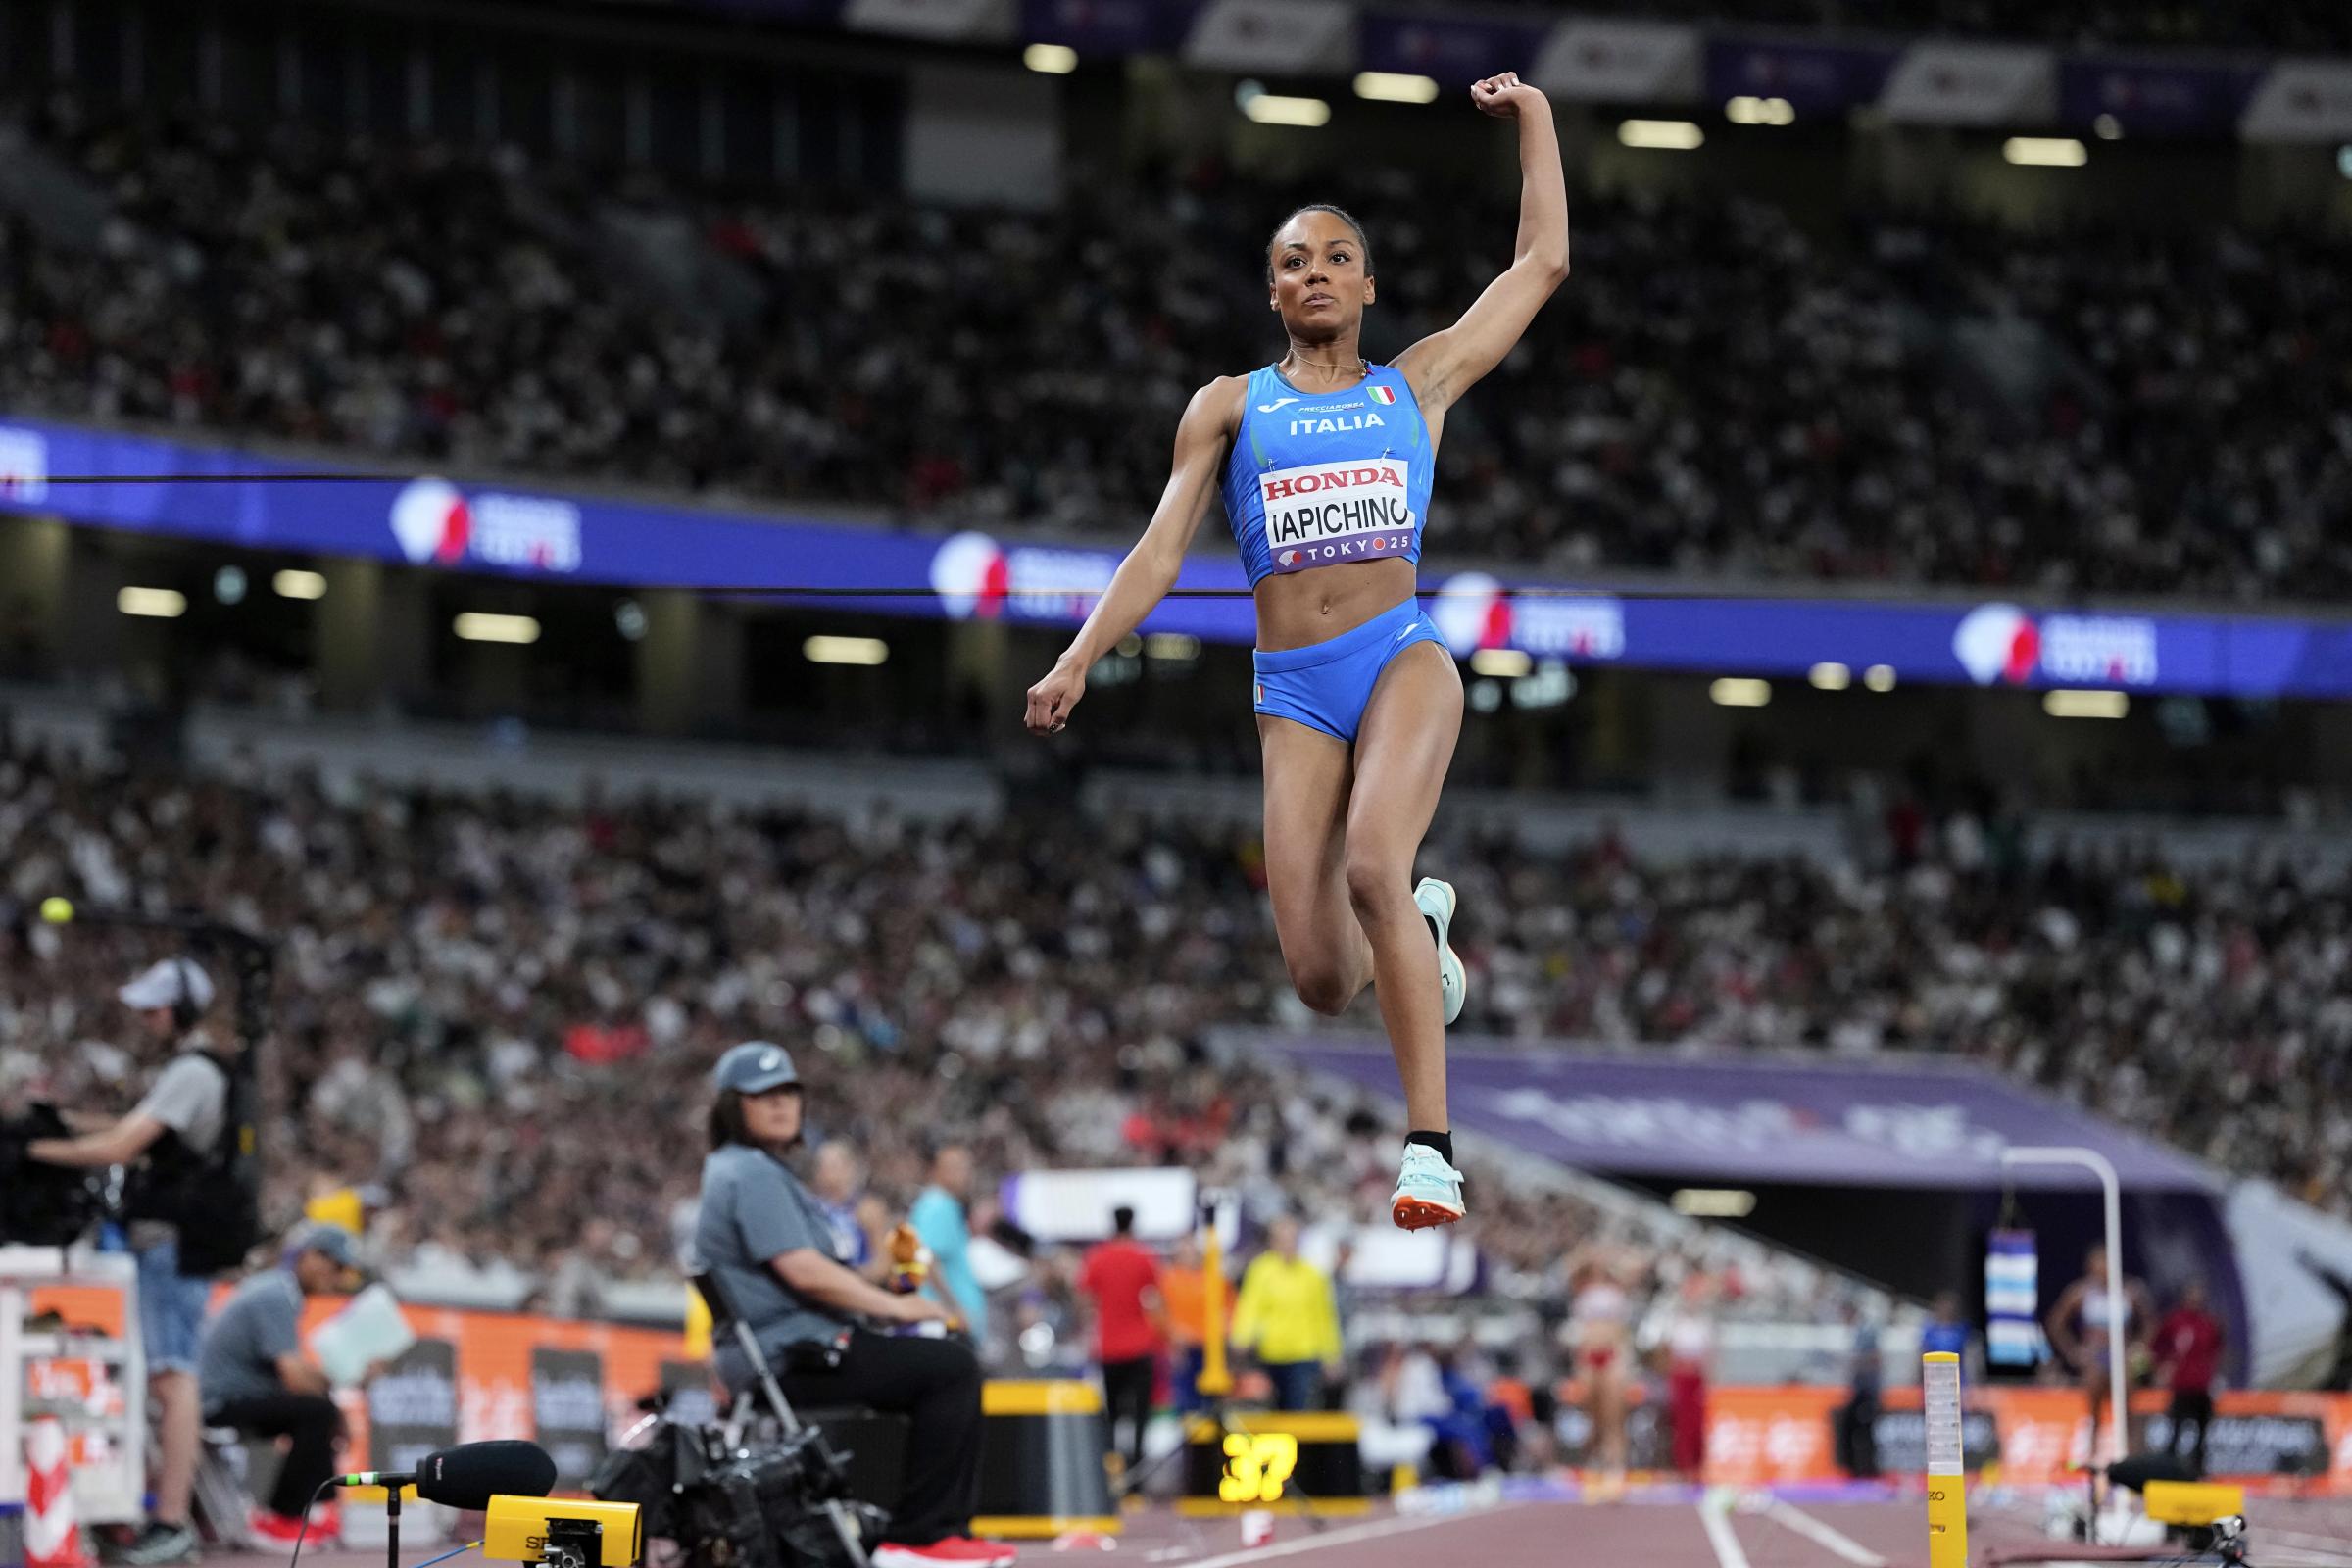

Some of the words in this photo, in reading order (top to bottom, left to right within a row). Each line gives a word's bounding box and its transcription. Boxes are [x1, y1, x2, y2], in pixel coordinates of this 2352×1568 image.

[1290, 413, 1385, 436] ITALIA
[1264, 467, 1404, 501] HONDA
[1218, 1433, 1298, 1502] 37
